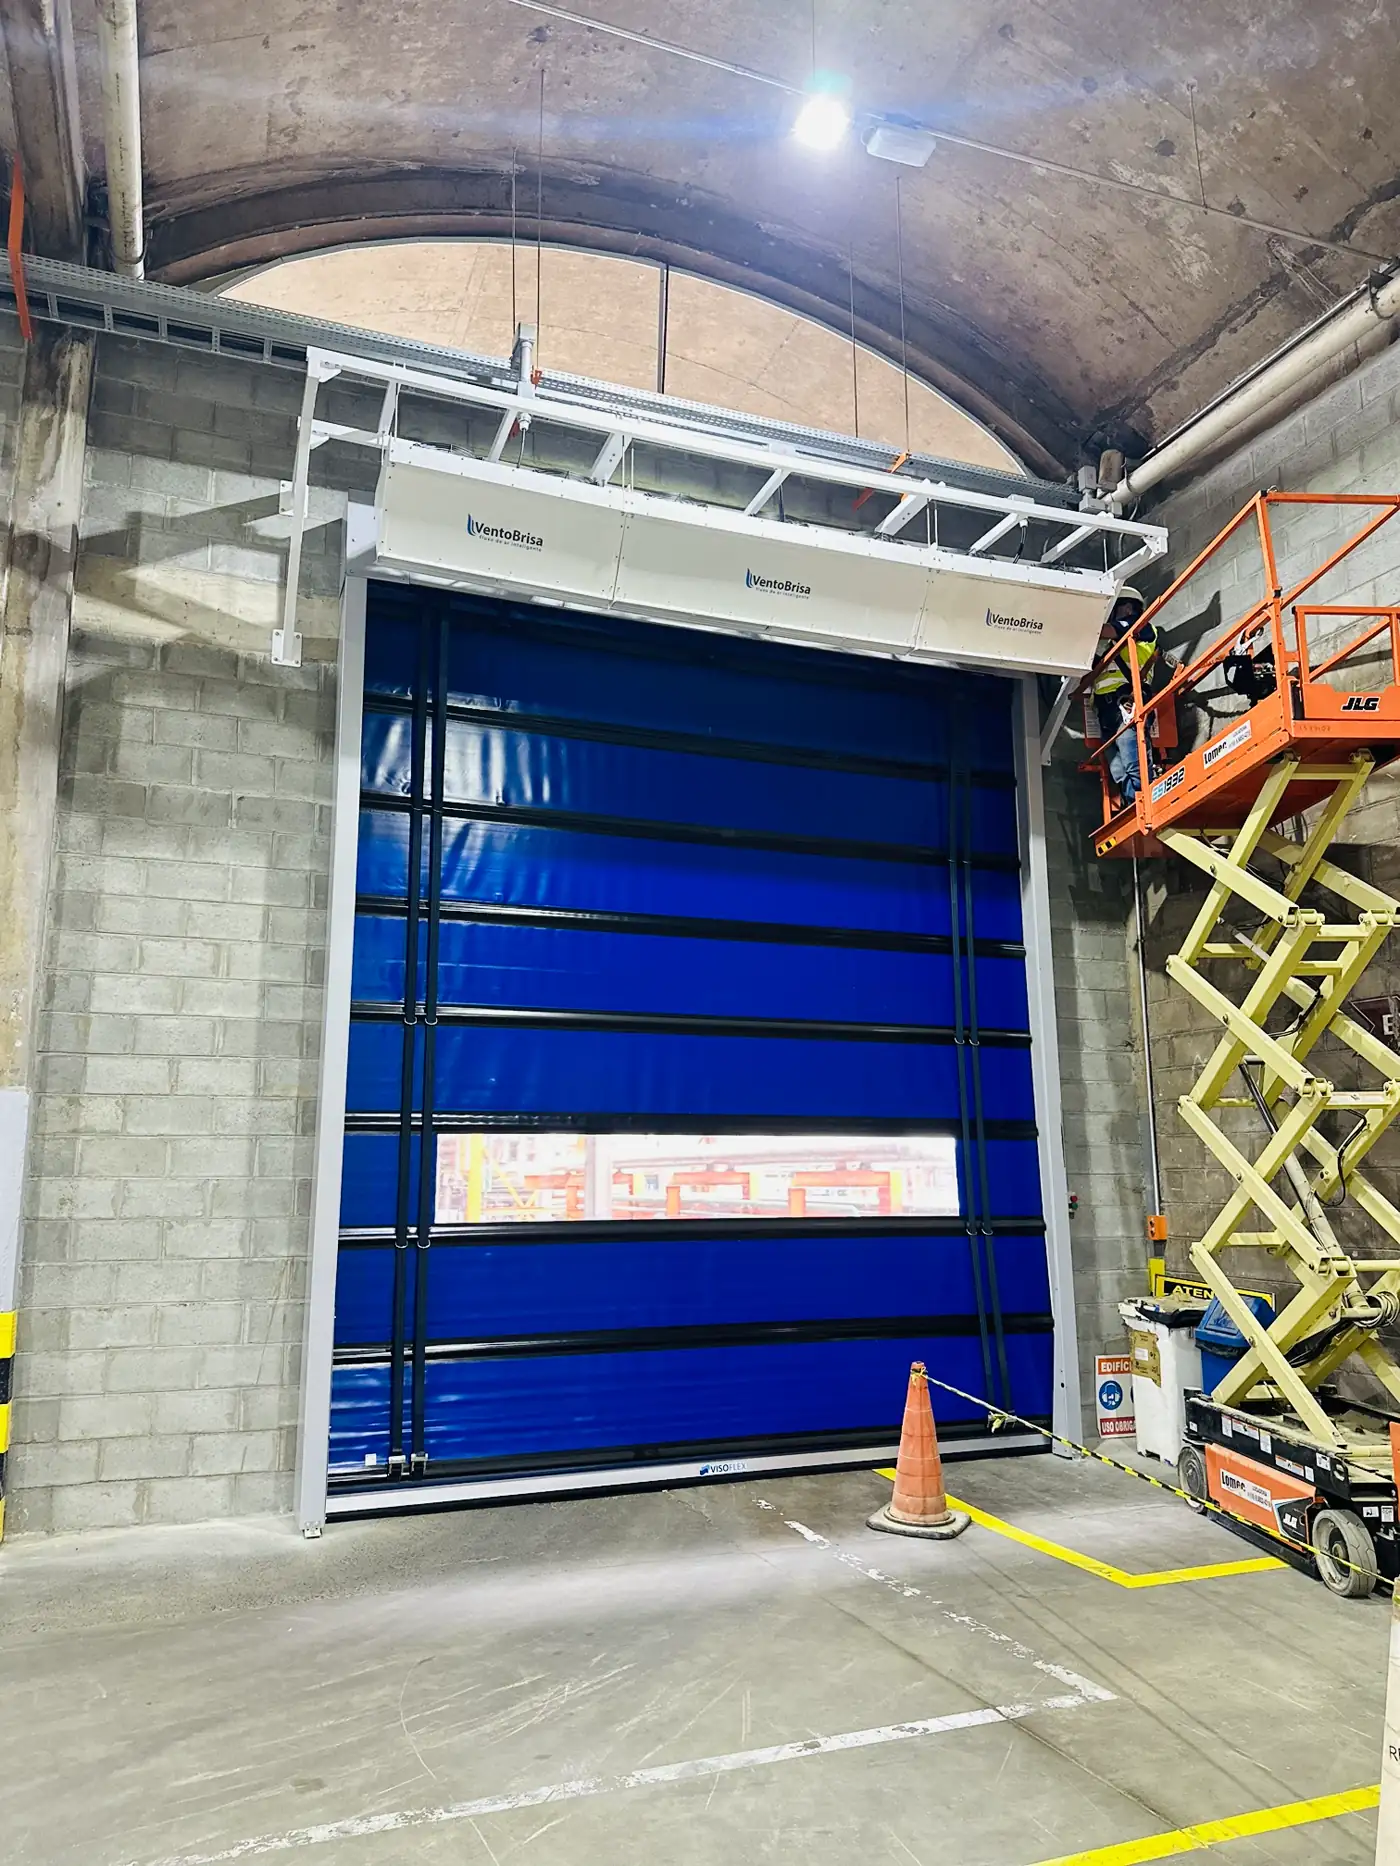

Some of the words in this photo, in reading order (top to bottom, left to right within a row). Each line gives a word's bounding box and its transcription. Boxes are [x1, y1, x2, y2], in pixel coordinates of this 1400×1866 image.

[475, 521, 544, 547] VentoBrisa
[753, 574, 811, 595] VentoBrisa
[992, 613, 1044, 630] VentoBrisa
[1341, 697, 1380, 711] JLG
[710, 1462, 747, 1473] VISOFLEX
